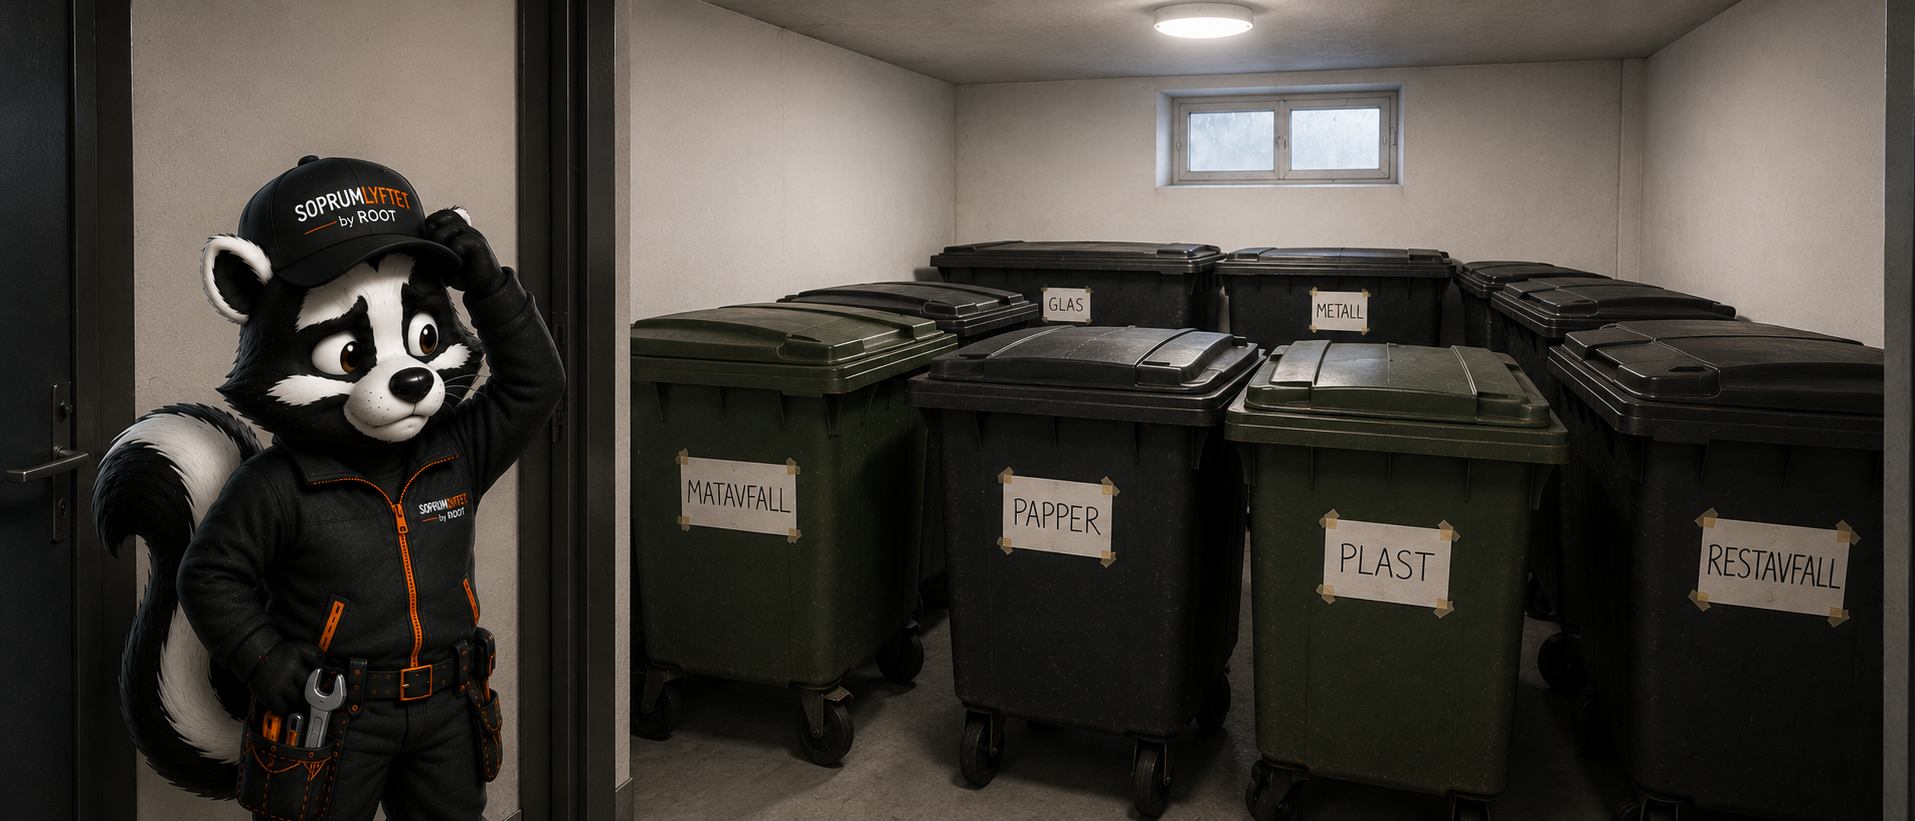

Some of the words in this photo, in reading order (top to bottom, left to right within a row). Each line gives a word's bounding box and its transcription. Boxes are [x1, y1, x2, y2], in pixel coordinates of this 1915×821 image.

[295, 186, 410, 222] SOPRUMLYFTET
[339, 216, 354, 228] by
[357, 209, 396, 224] ROOT
[1048, 296, 1085, 313] GLAS
[1316, 302, 1365, 320] METALL
[686, 479, 792, 514] MATAVFALL
[438, 514, 446, 522] by
[1014, 497, 1101, 536] PAPPER
[1340, 542, 1436, 583] PLAST
[1707, 543, 1842, 590] RESTAVFALL
